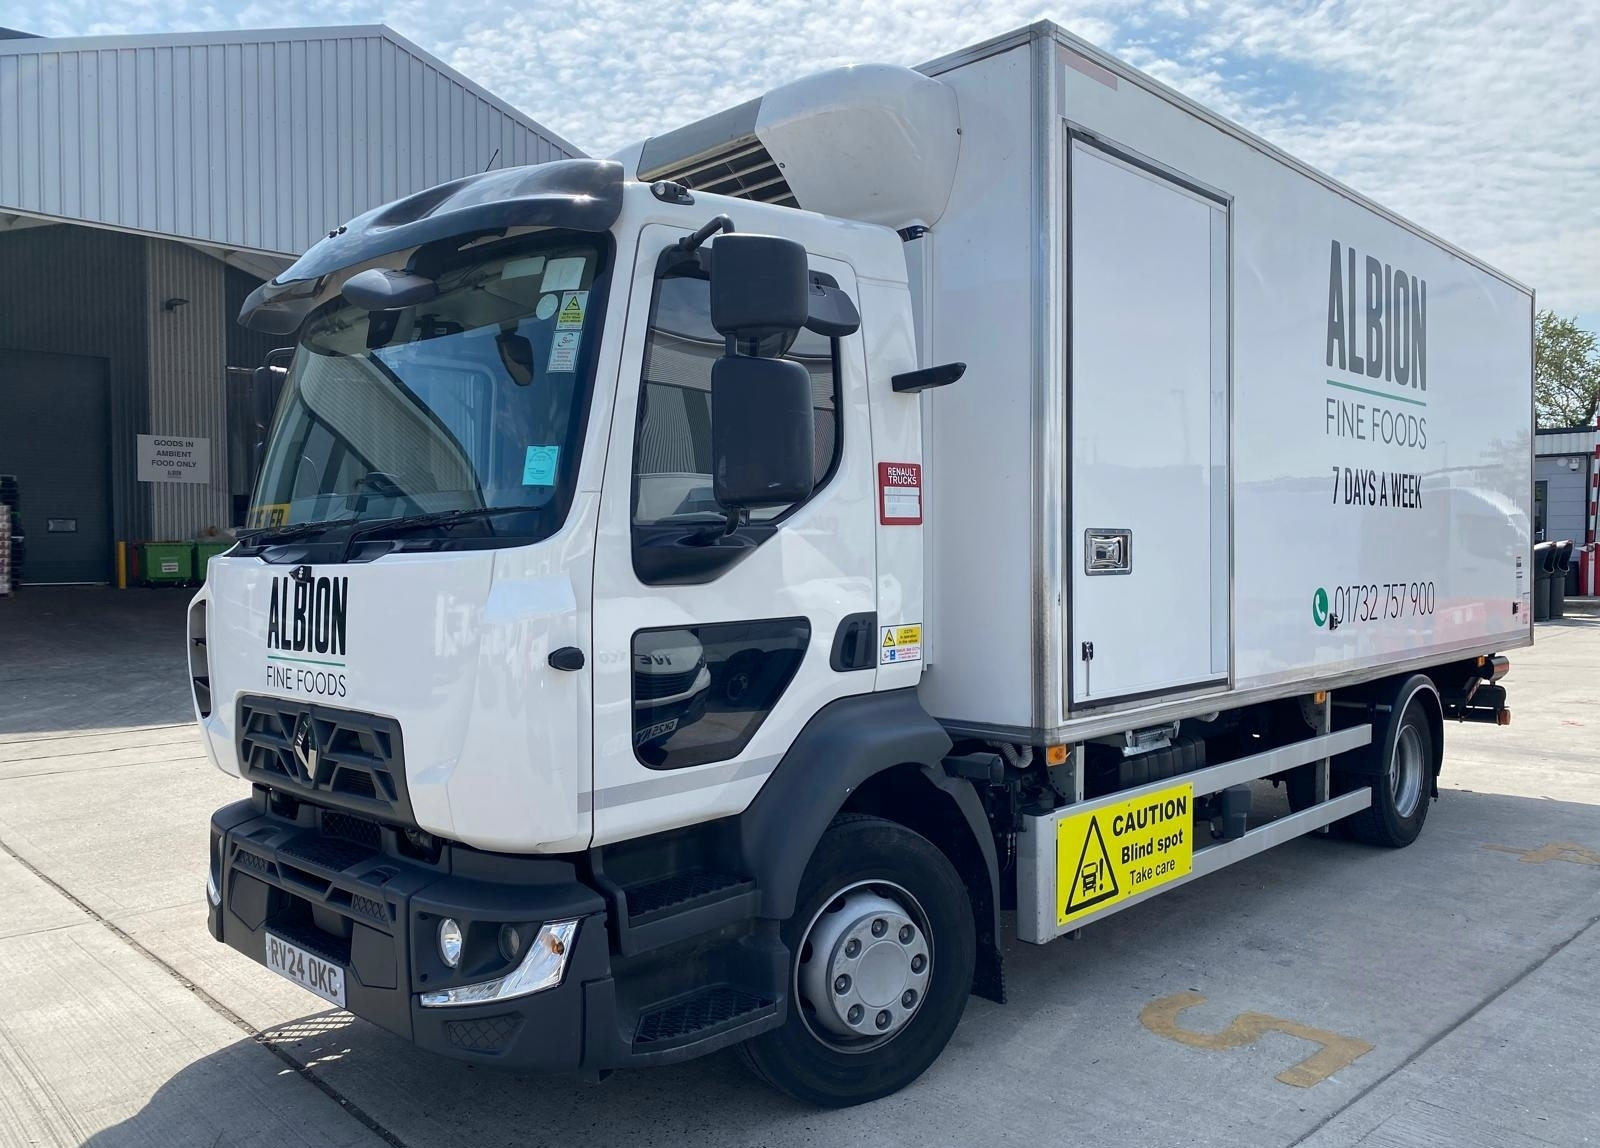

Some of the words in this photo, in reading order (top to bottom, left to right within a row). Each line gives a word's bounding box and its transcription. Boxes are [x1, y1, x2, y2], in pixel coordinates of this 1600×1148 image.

[1326, 240, 1427, 391] ALBION
[1326, 397, 1366, 440] FINE
[1372, 407, 1427, 450] FOODS
[153, 439, 184, 448] GOODS
[156, 450, 192, 458] AMBIENT
[151, 459, 175, 467] FOOD
[176, 460, 197, 468] ONLY
[887, 467, 917, 477] RENAULT
[888, 475, 917, 485] TRUCKS
[1332, 466, 1340, 505] 7
[1344, 467, 1377, 506] DAYS
[1379, 472, 1388, 507] A
[1390, 472, 1422, 509] WEEK
[267, 576, 349, 656] ALBION
[1334, 585, 1379, 624] 01732
[1383, 583, 1407, 620] 757
[1410, 581, 1435, 617] 900
[266, 665, 293, 690] FINE
[297, 669, 347, 698] FOODS
[1112, 796, 1187, 836] CAUTION
[1121, 838, 1153, 864] Blind
[1157, 829, 1183, 854] spot
[1129, 865, 1153, 886] Take
[1155, 857, 1176, 877] care
[270, 937, 306, 981] RV24
[308, 957, 338, 997] OKC
